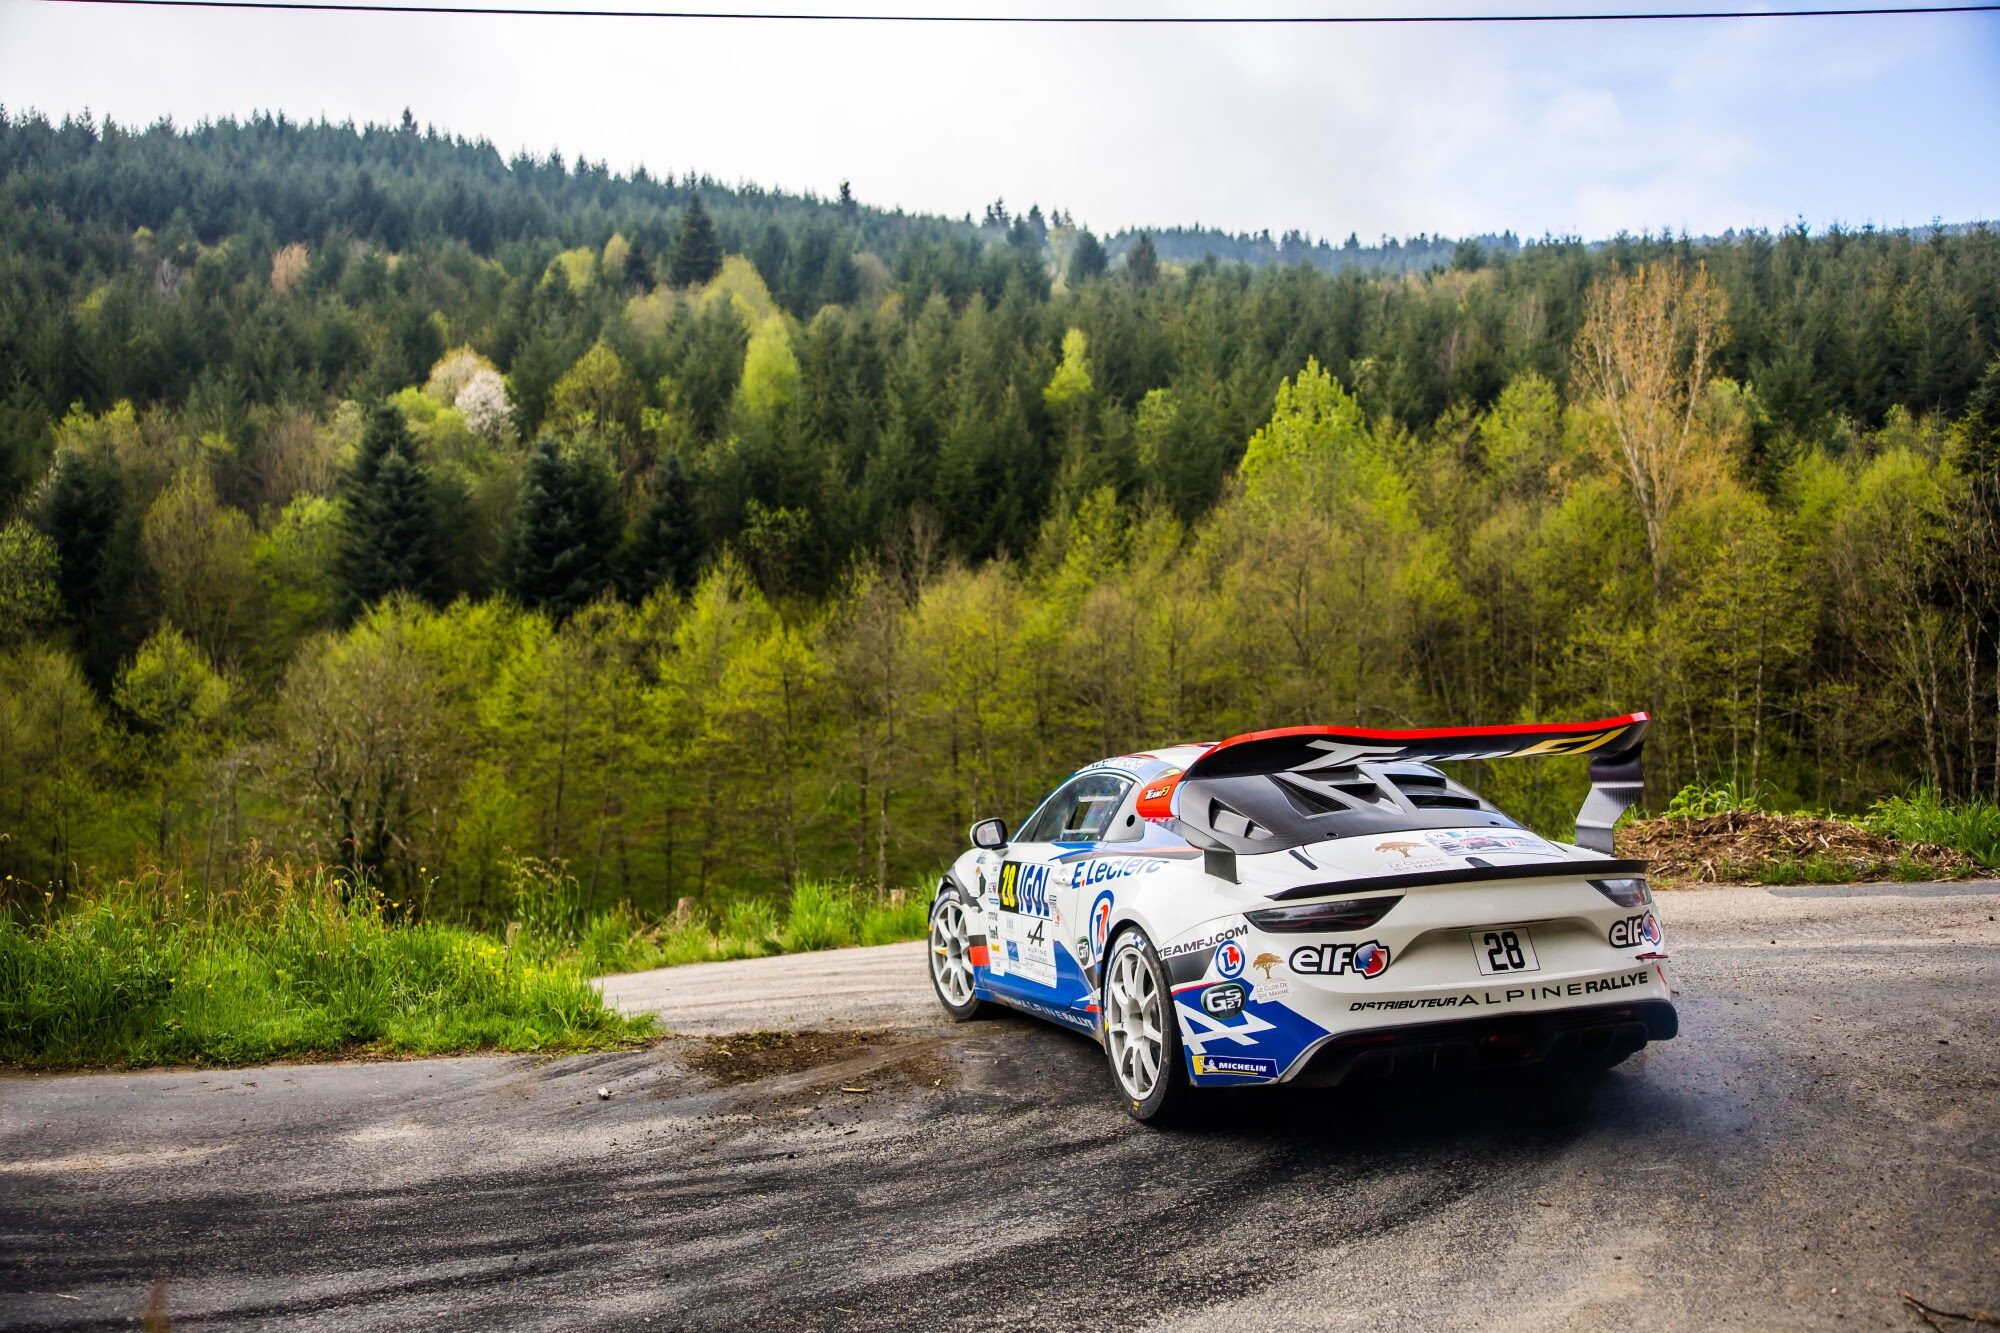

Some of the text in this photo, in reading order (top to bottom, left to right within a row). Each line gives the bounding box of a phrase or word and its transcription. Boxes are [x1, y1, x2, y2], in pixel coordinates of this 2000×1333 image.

[1002, 864, 1051, 917] 28 IGOL
[1071, 857, 1169, 889] E.Leclerc
[1609, 914, 1642, 949] elf
[1289, 944, 1357, 975] elf
[1483, 931, 1526, 972] 28
[1349, 971, 1649, 1012] DISTRIBUTEUR ALPINE RALLYE
[1218, 1061, 1268, 1073] MICHELIN
